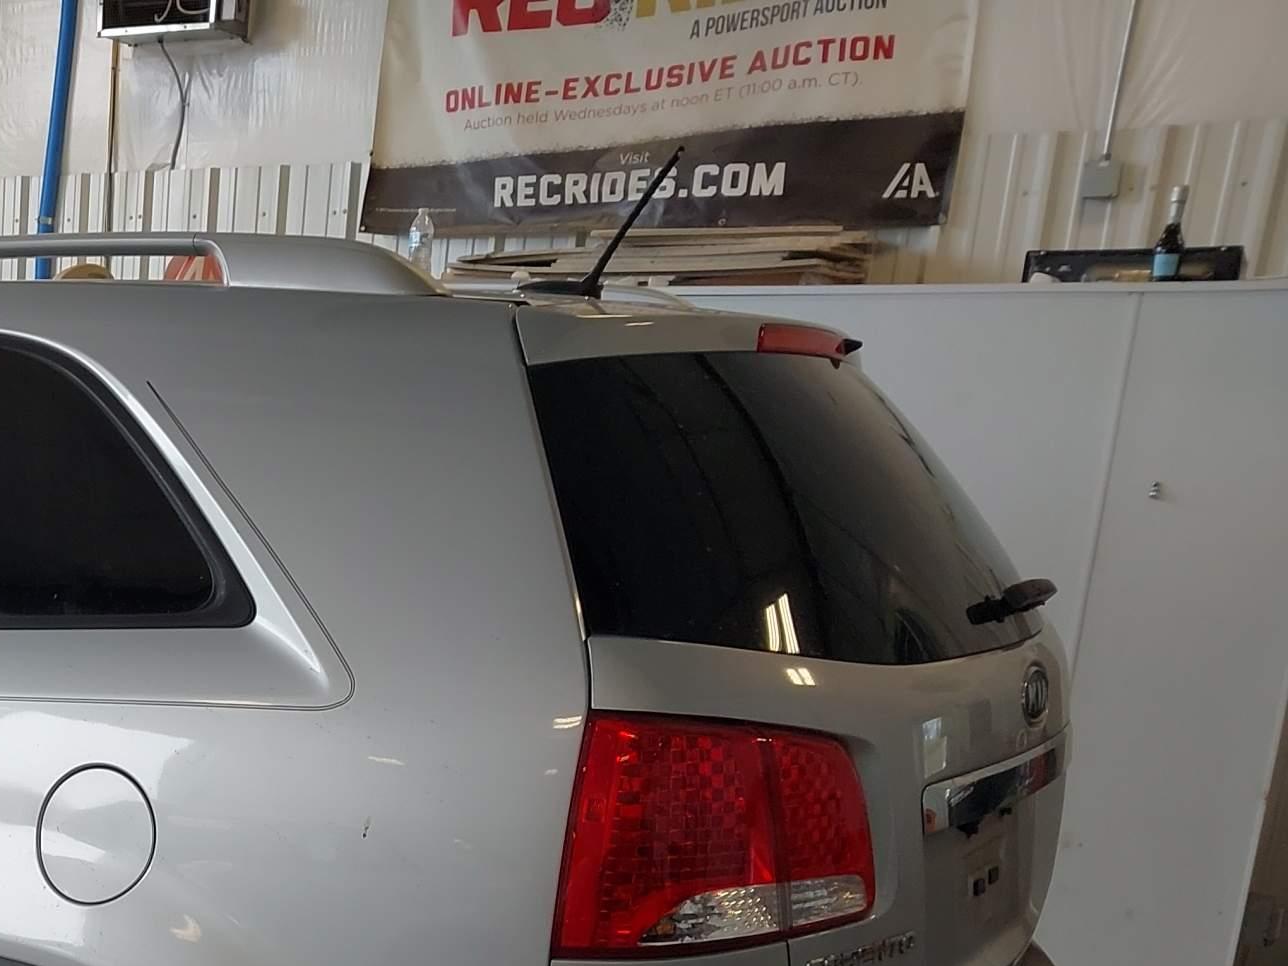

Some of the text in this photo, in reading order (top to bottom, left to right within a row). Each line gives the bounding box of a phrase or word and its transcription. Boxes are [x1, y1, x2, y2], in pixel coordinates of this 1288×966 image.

[690, 19, 700, 39] A
[704, 0, 809, 37] POWERSPORT
[445, 34, 896, 113] ONLINE-EXCLUSIVE AUCTION
[464, 114, 512, 132] Auction
[516, 110, 548, 125] held
[553, 99, 647, 122] Wednesdays
[651, 98, 665, 111] at
[670, 93, 709, 108] noon
[714, 87, 735, 102] ET
[787, 77, 822, 91] a.m.
[619, 151, 650, 166] Visit
[494, 162, 787, 208] RECRIDES.COM
